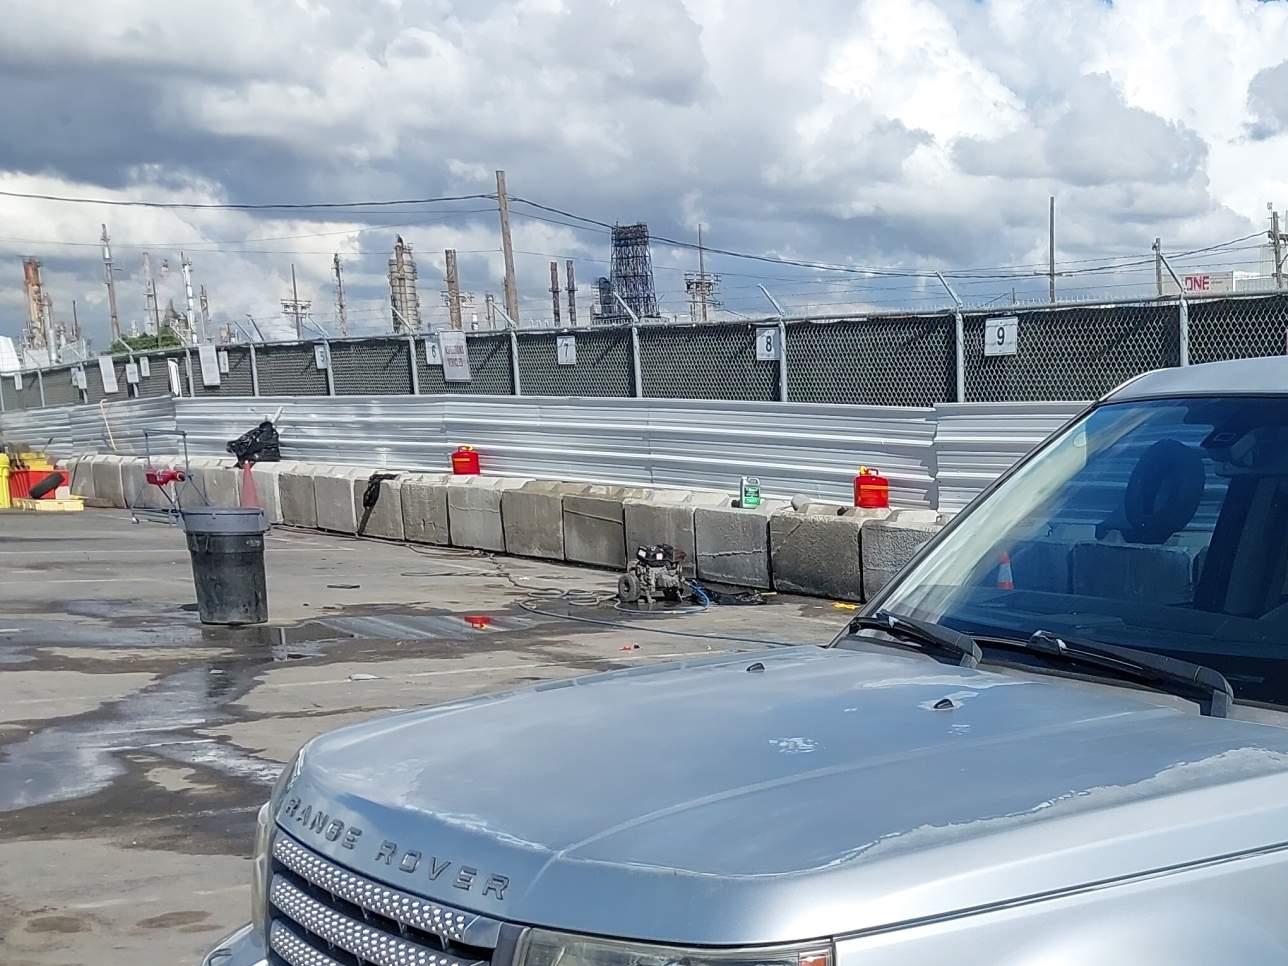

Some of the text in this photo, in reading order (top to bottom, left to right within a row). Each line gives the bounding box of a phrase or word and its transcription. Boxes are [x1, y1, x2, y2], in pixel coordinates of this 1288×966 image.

[1184, 276, 1210, 291] ONE
[765, 335, 772, 352] 8
[997, 326, 1005, 345] 9
[285, 797, 511, 900] RANGE ROVER
